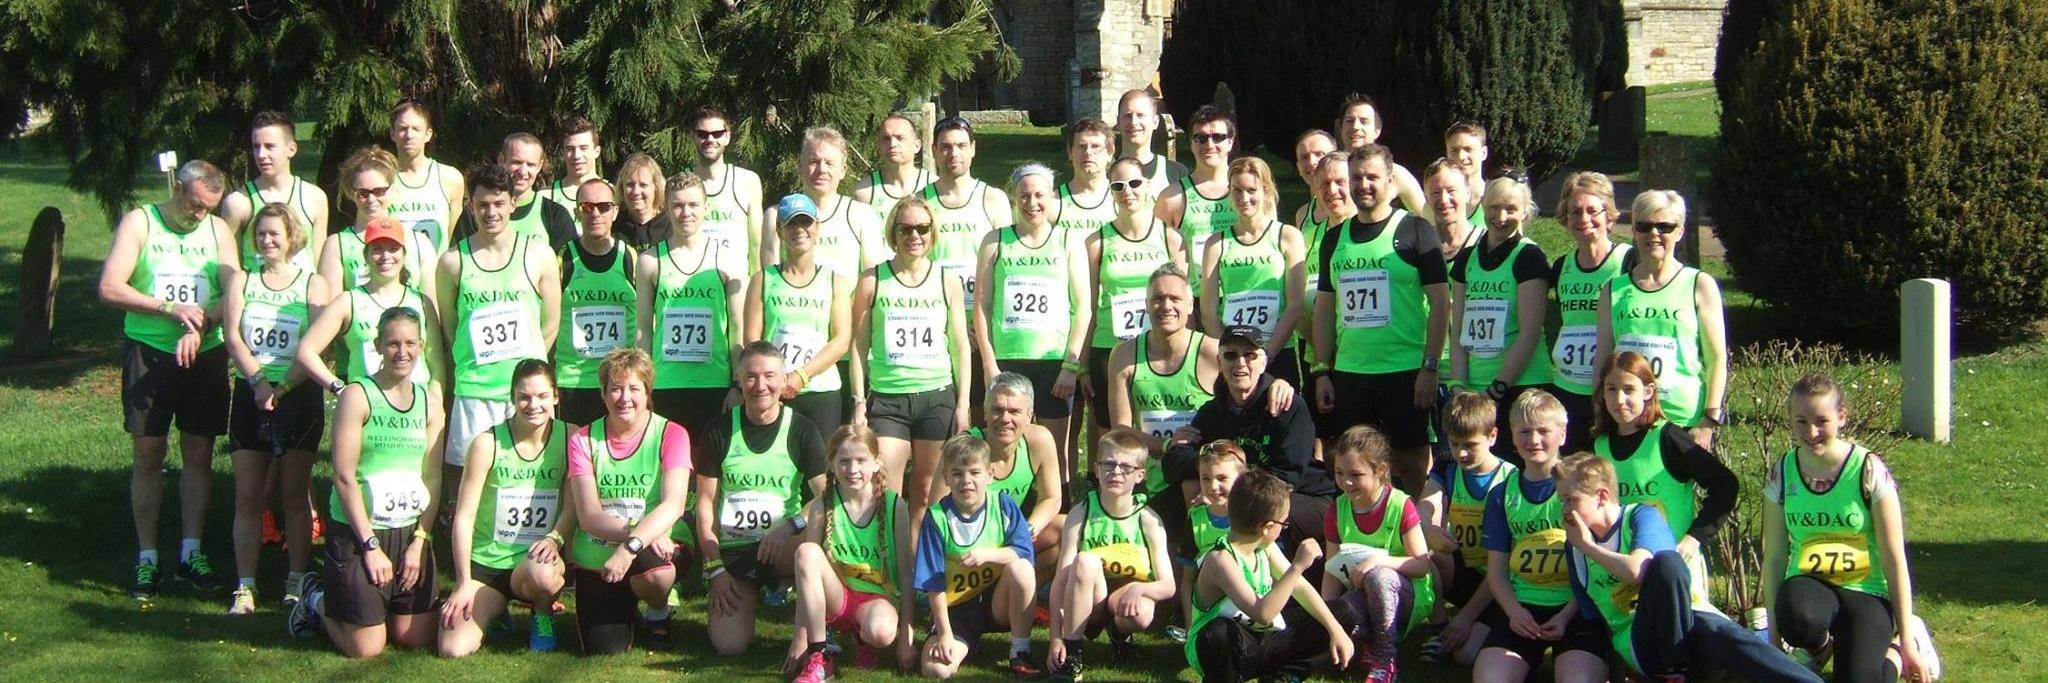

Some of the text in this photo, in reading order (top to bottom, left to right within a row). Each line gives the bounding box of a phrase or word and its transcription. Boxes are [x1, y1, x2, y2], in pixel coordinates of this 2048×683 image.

[939, 222, 978, 233] &DAC
[1107, 250, 1162, 264] W&DAC
[1332, 257, 1389, 272] W&DAC
[165, 284, 199, 303] 361
[570, 289, 629, 302] W&DAC
[658, 287, 717, 301] W&DAC
[1468, 280, 1510, 293] &DAC
[1560, 282, 1602, 295] W&DA
[464, 289, 526, 305] W&DAC
[1012, 292, 1048, 314] 328
[1346, 288, 1378, 311] 371
[1123, 310, 1146, 330] 27
[1233, 305, 1268, 326] 475
[1617, 306, 1682, 323] W&DAC
[253, 326, 289, 349] 369
[482, 320, 518, 346] 337
[583, 321, 619, 342] 374
[672, 324, 706, 345] 373
[895, 327, 933, 347] 314
[1468, 317, 1496, 341] 437
[779, 342, 814, 364] 476
[1135, 393, 1196, 408] W&DAC
[371, 415, 425, 430] W&DAC
[496, 466, 560, 481] W&DAC
[600, 473, 652, 487] &DAC
[726, 471, 790, 488] W&DAC
[1618, 481, 1659, 497] DAC
[385, 490, 420, 512] 349
[507, 506, 548, 529] 332
[734, 509, 772, 531] 299
[1511, 518, 1563, 534] W&DA
[1787, 511, 1860, 528] W&DAC
[834, 543, 881, 560] W&DA
[1520, 548, 1566, 574] 277
[1808, 551, 1857, 575] 275
[953, 566, 994, 594] 209
